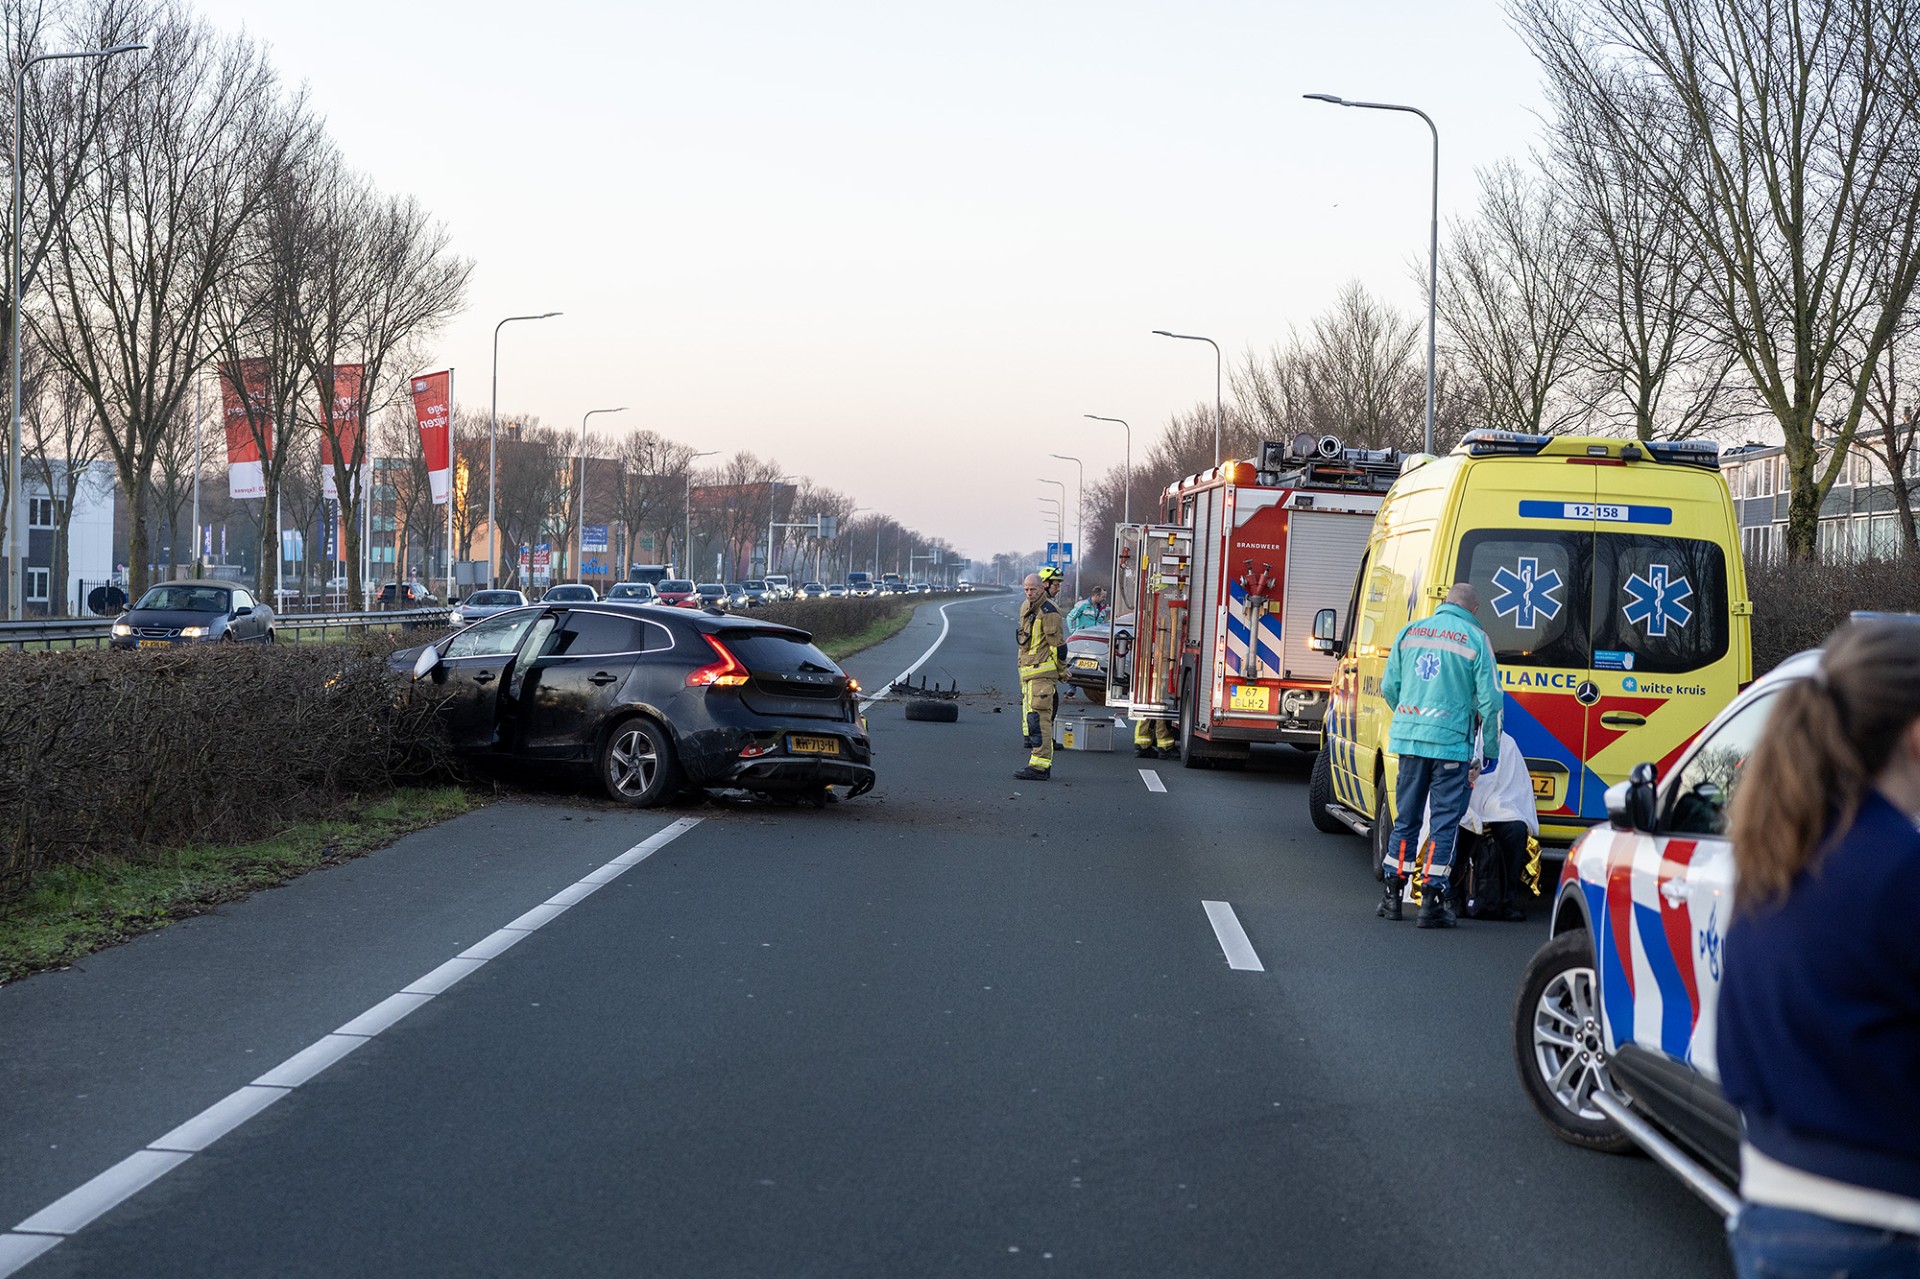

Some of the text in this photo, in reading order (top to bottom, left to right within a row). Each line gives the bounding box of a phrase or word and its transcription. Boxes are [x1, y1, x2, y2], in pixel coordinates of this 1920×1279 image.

[1574, 506, 1618, 518] 12-158
[1237, 542, 1280, 550] BRANDWEER
[1407, 627, 1469, 644] AMBULANCE
[782, 674, 833, 683] VOLVO
[1245, 688, 1258, 697] 67
[1640, 682, 1706, 696] witte kruis
[1235, 698, 1264, 709] BLH-2
